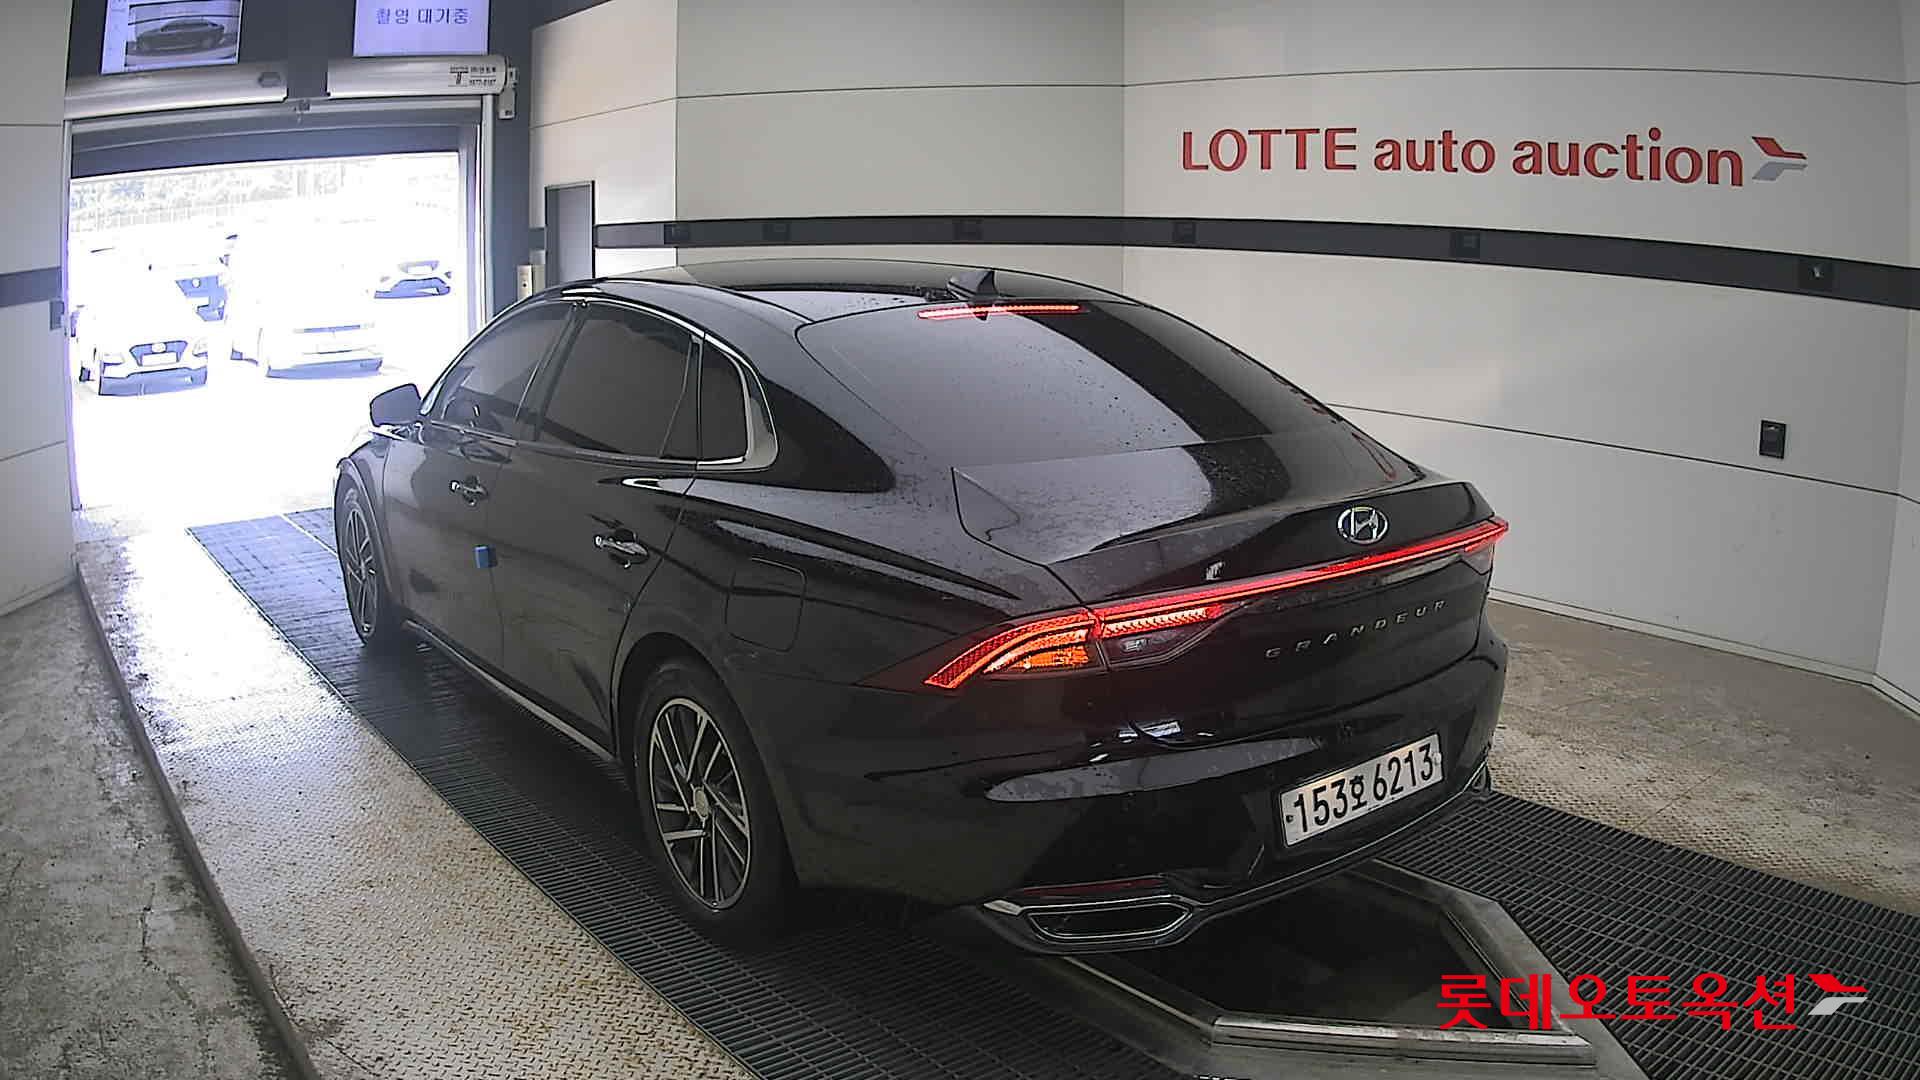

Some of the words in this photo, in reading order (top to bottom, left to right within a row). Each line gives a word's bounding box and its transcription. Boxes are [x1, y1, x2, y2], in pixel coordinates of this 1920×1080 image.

[417, 8, 469, 24] 대기중
[1182, 127, 1357, 172] LOTTE
[1373, 129, 1497, 174] auto
[1511, 127, 1744, 187] auction
[1265, 600, 1446, 658] GRANDEUR
[1372, 743, 1434, 801] 6213
